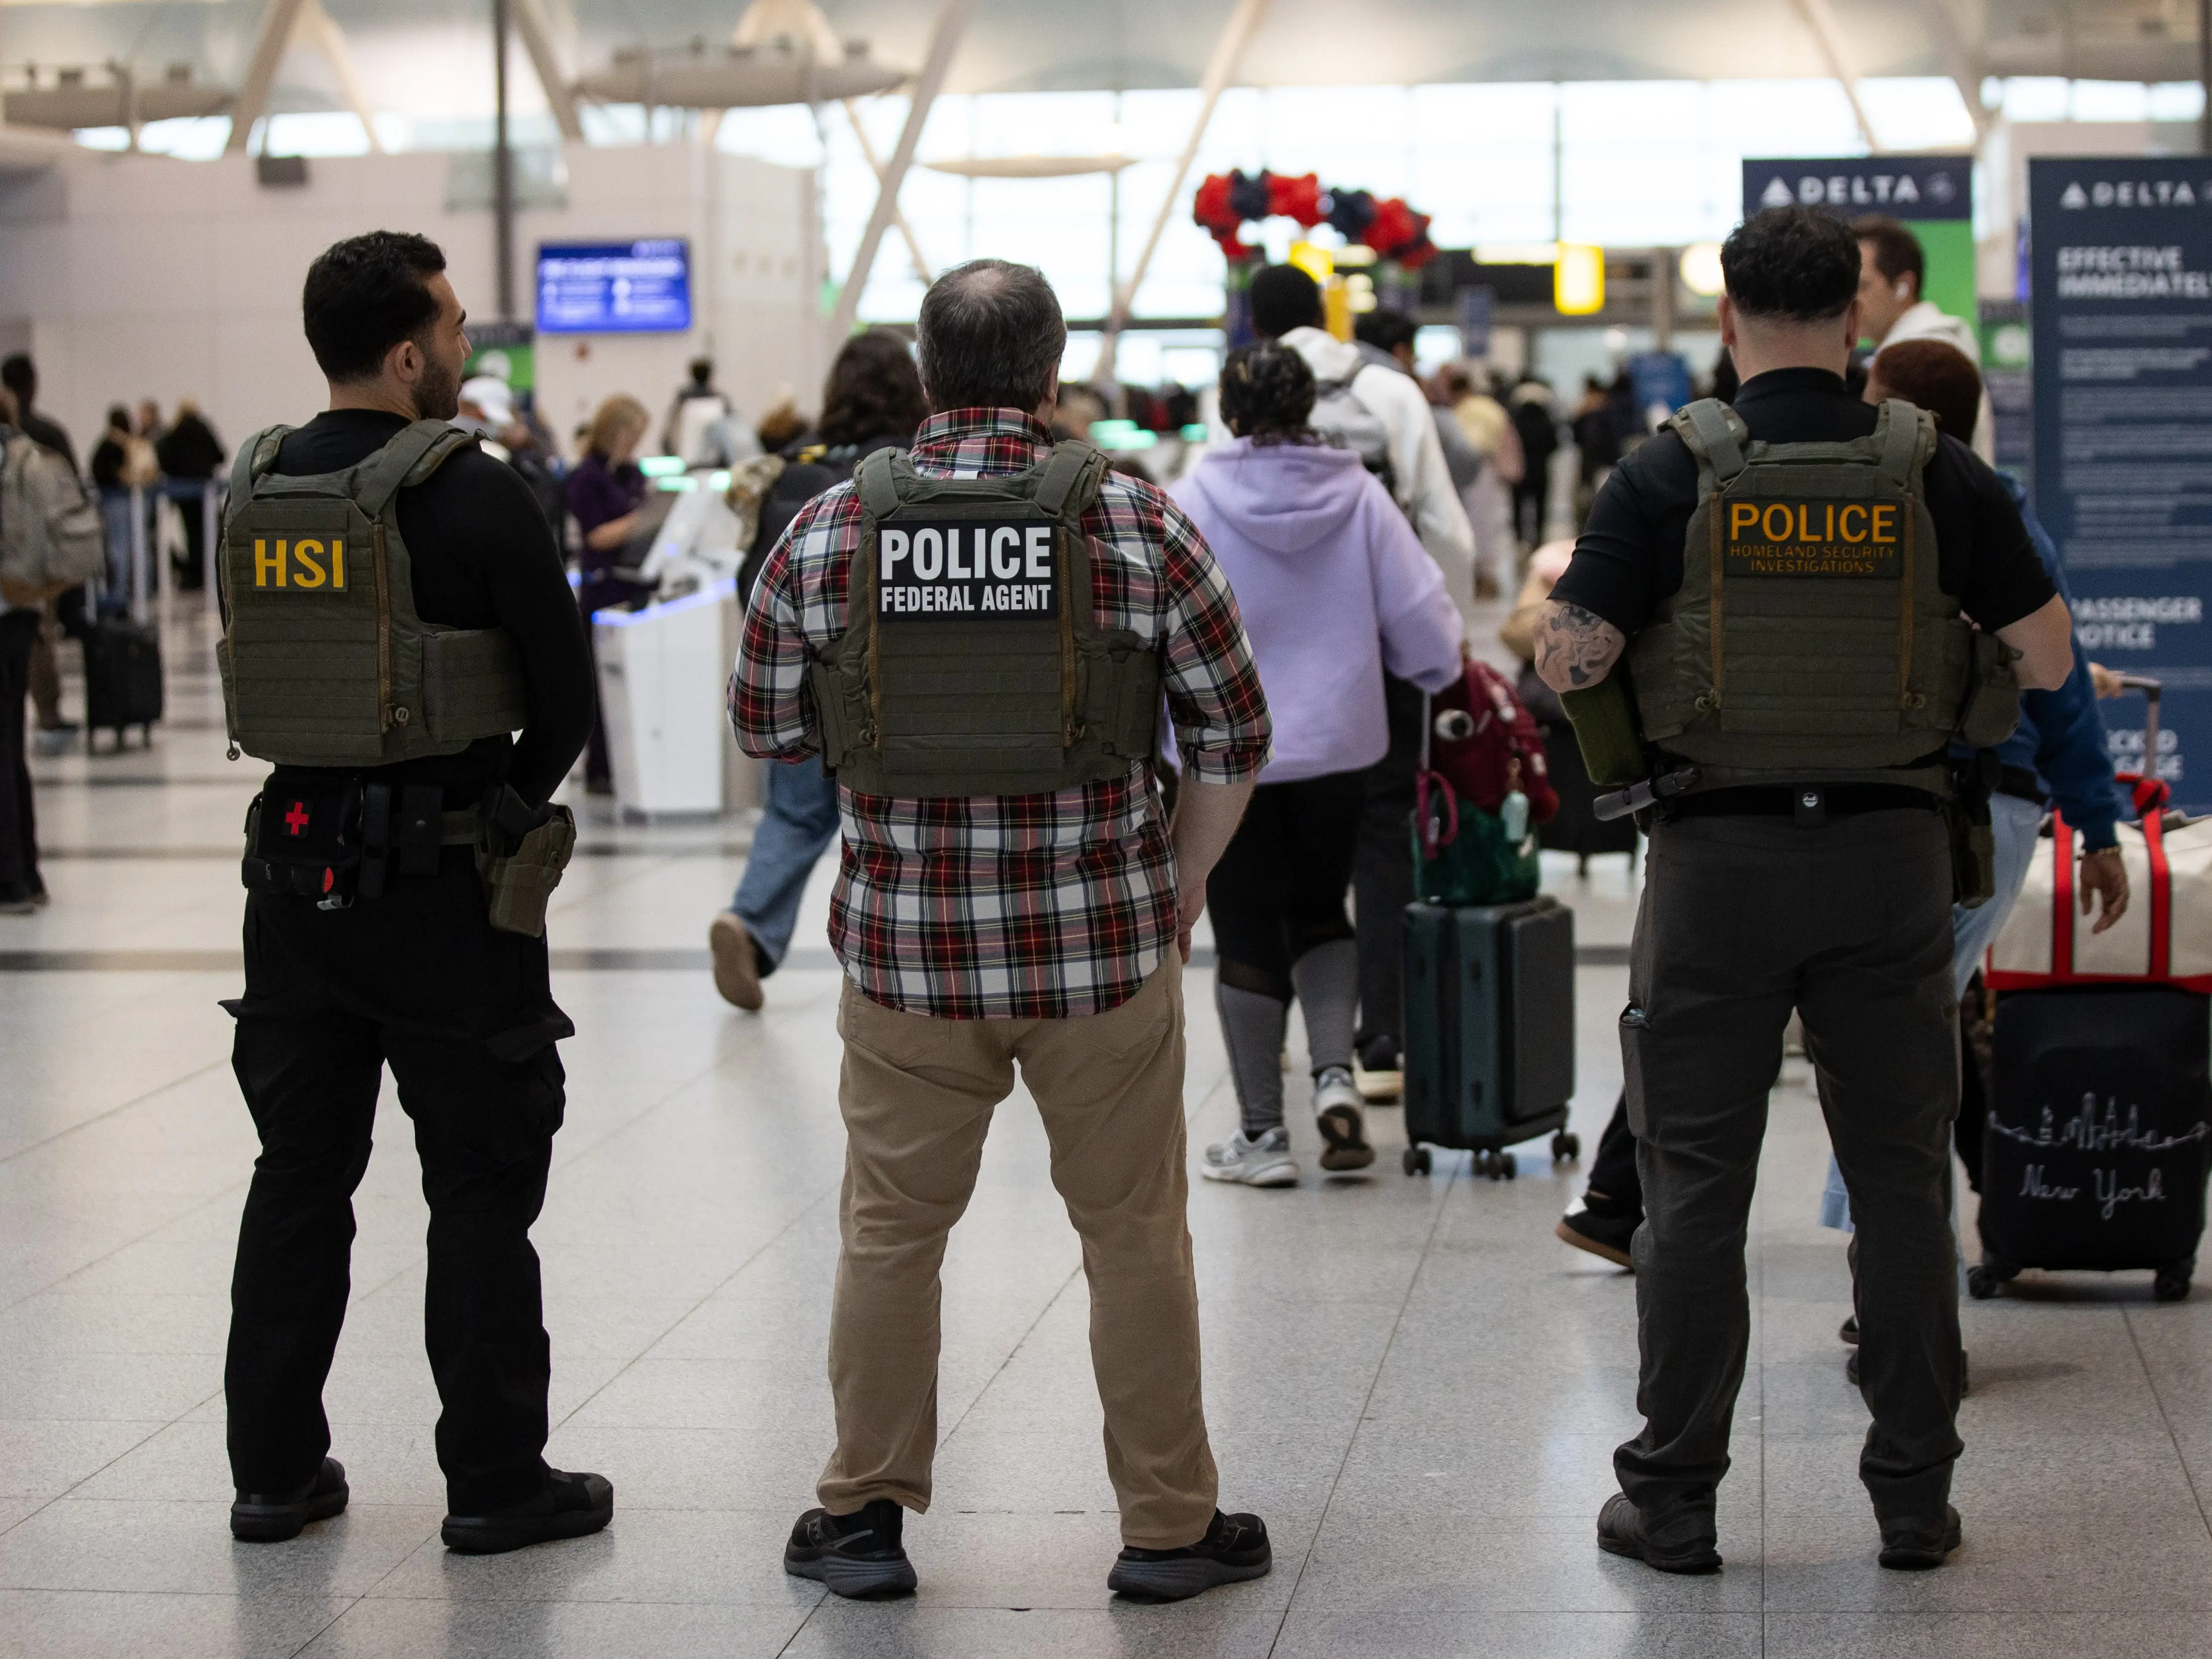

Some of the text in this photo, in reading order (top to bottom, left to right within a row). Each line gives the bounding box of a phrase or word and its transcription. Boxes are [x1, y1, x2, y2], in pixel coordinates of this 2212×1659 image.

[1798, 174, 1920, 205] DELTA
[2092, 180, 2197, 208] DELTA
[2057, 246, 2184, 271] EFFECTIVE
[2057, 272, 2212, 298] IMMEDIATEL
[1730, 502, 1897, 543] POLICE
[254, 539, 343, 588] HSI
[881, 527, 1051, 580] POLICE
[1730, 544, 1895, 559] HOMELAND SECURITY
[1750, 559, 1875, 573] INVESTIGATIONS
[881, 584, 1051, 612] FEDERAL AGENT
[2019, 1164, 2167, 1220] New York
